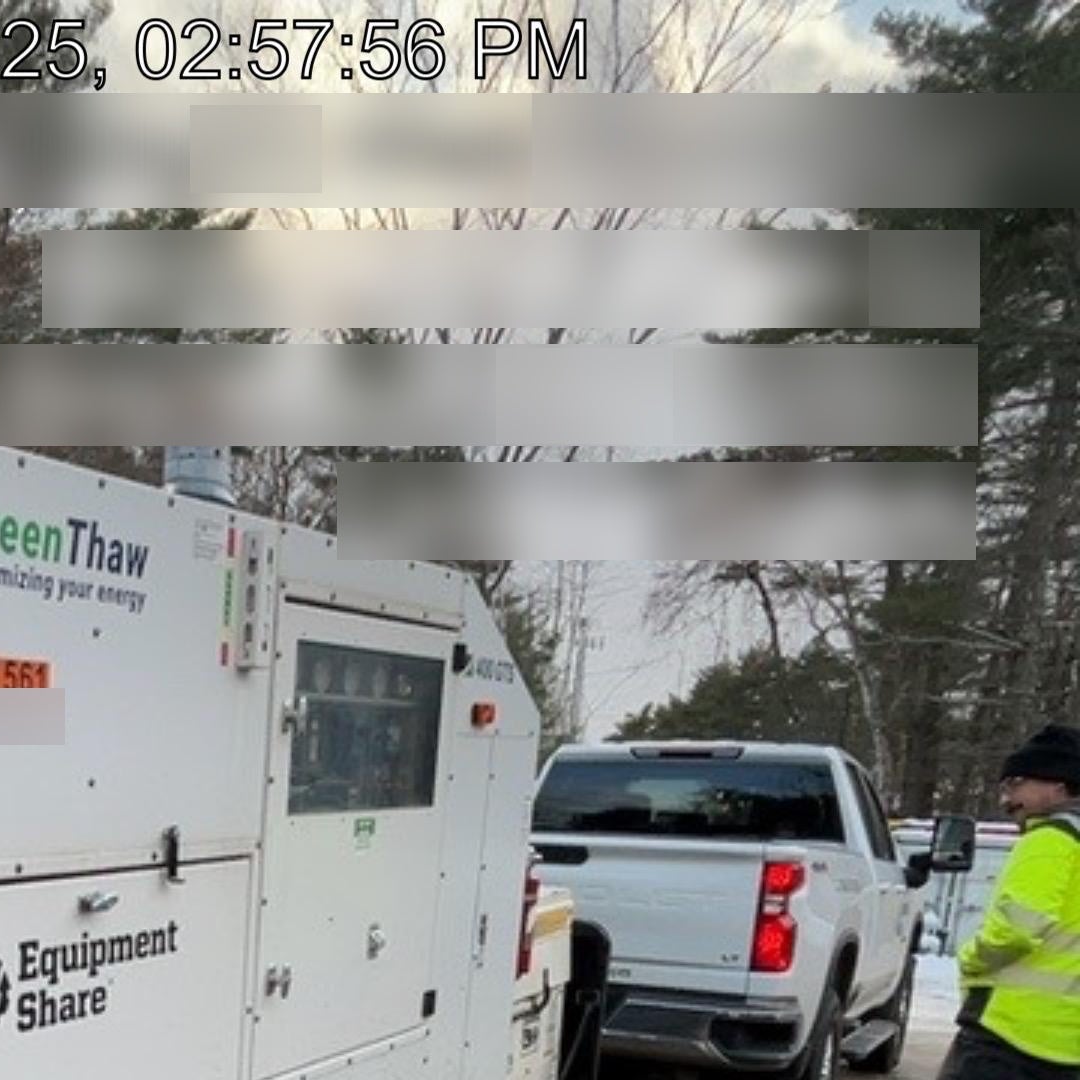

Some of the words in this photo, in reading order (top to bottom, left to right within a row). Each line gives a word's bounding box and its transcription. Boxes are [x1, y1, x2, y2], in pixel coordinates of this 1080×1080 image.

[56, 578, 94, 602] your
[97, 584, 147, 614] energy
[18, 920, 178, 985] Equipment
[18, 986, 106, 1032] Share
